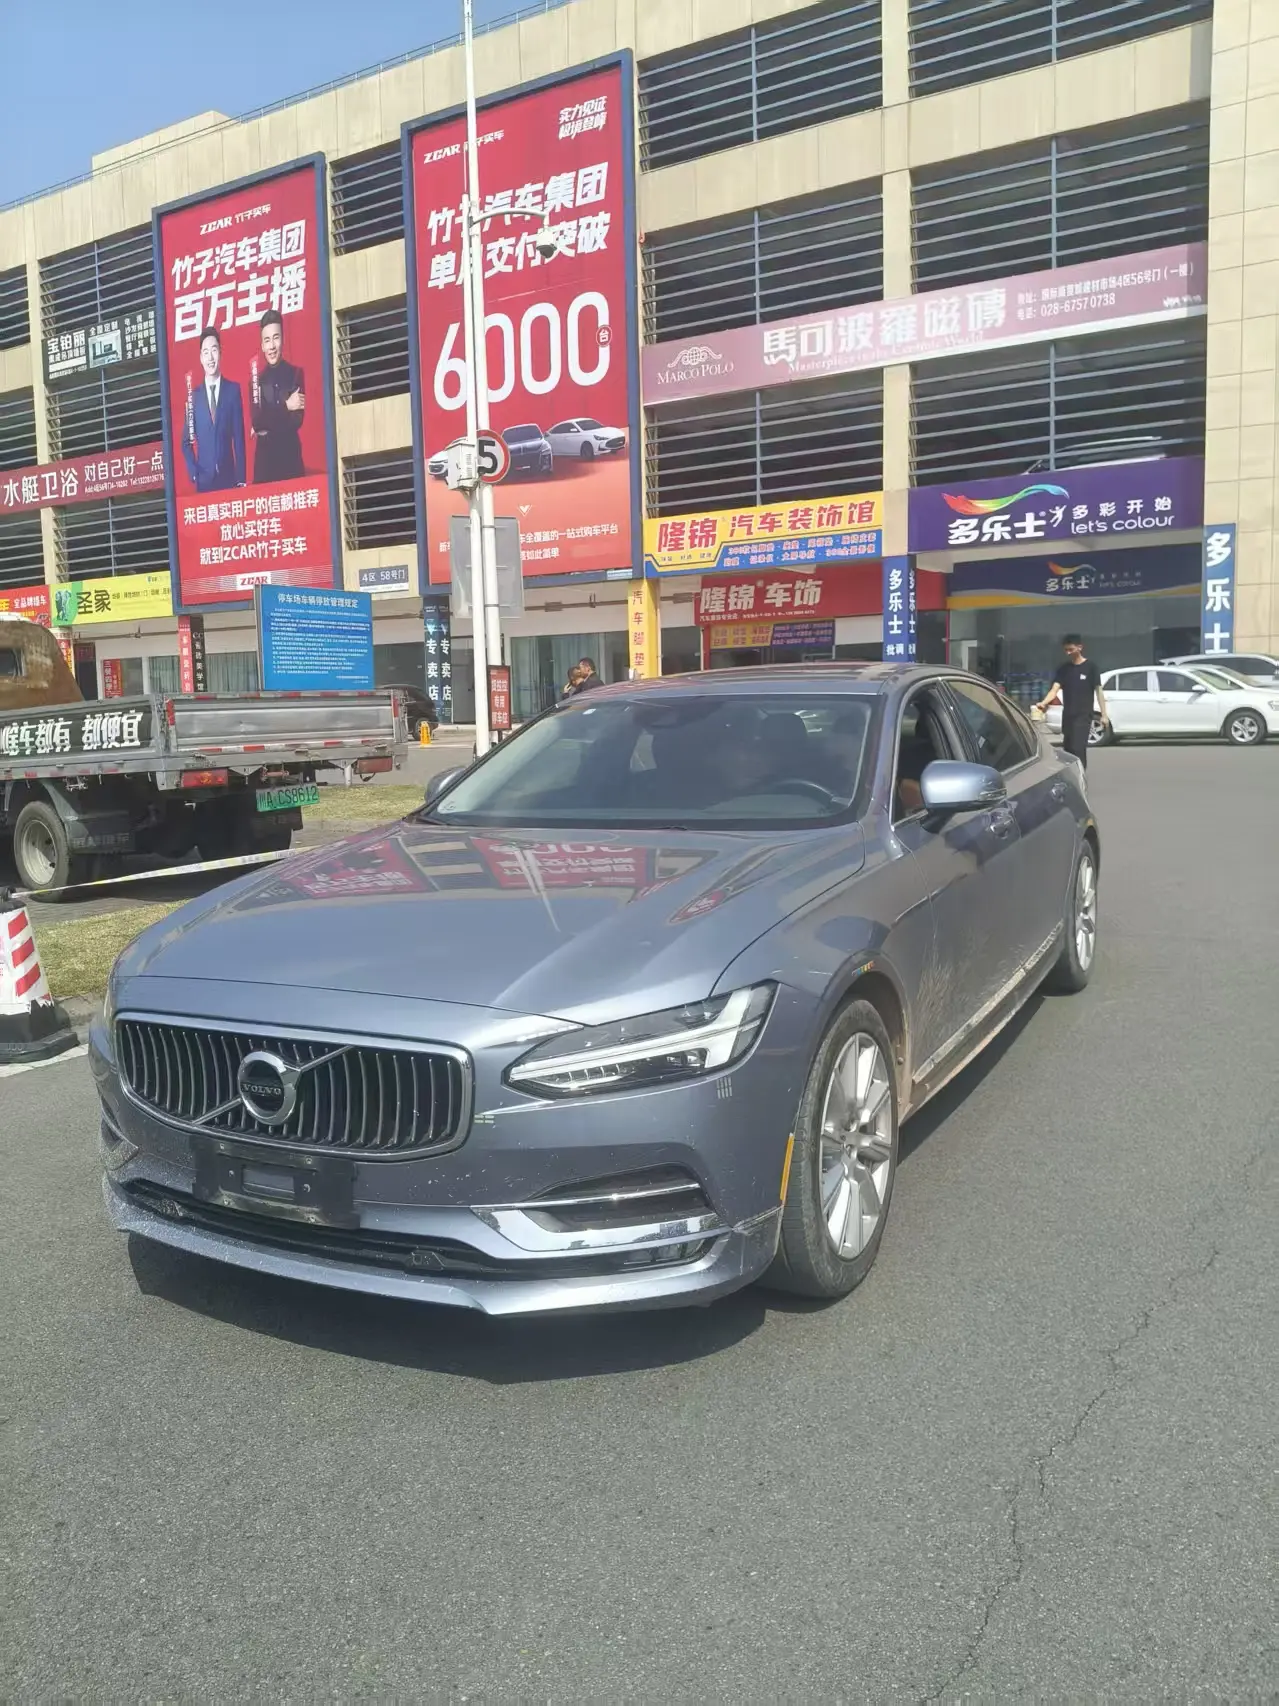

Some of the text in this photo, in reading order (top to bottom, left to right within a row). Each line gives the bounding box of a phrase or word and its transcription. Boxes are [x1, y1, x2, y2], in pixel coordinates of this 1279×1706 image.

[424, 143, 460, 164] ZCAR
[200, 216, 232, 235] ZCAR
[172, 220, 306, 291] 竹子汽车集团
[174, 260, 306, 342] 百万主播
[599, 329, 609, 343] 台
[433, 292, 610, 411] 6000
[657, 362, 734, 385] MARCO POLO
[84, 451, 164, 481] 对自己好一点
[478, 440, 498, 474] 5
[3, 467, 78, 507] 水艇卫浴
[184, 489, 319, 525] 来自真实用户的信赖推荐
[1071, 496, 1172, 520] 多彩开始
[220, 517, 282, 542] 放心买好车
[657, 500, 876, 553] 隆锦 汽车装饰馆
[947, 512, 1046, 545] 多乐士
[1070, 516, 1175, 535] let's colour
[200, 537, 307, 565] 就到ZCAR竹子买车
[240, 575, 268, 586] ZCAR
[362, 569, 405, 582] 4区 58号门
[76, 589, 111, 615] 圣象
[699, 578, 823, 614] 隆锦 车饰
[888, 569, 903, 634] 多乐士
[1204, 532, 1231, 655] 多乐士
[426, 638, 439, 702] 专卖店
[440, 638, 452, 702] 专卖店
[278, 786, 318, 805] CS8612
[242, 1083, 281, 1096] VOLVO
